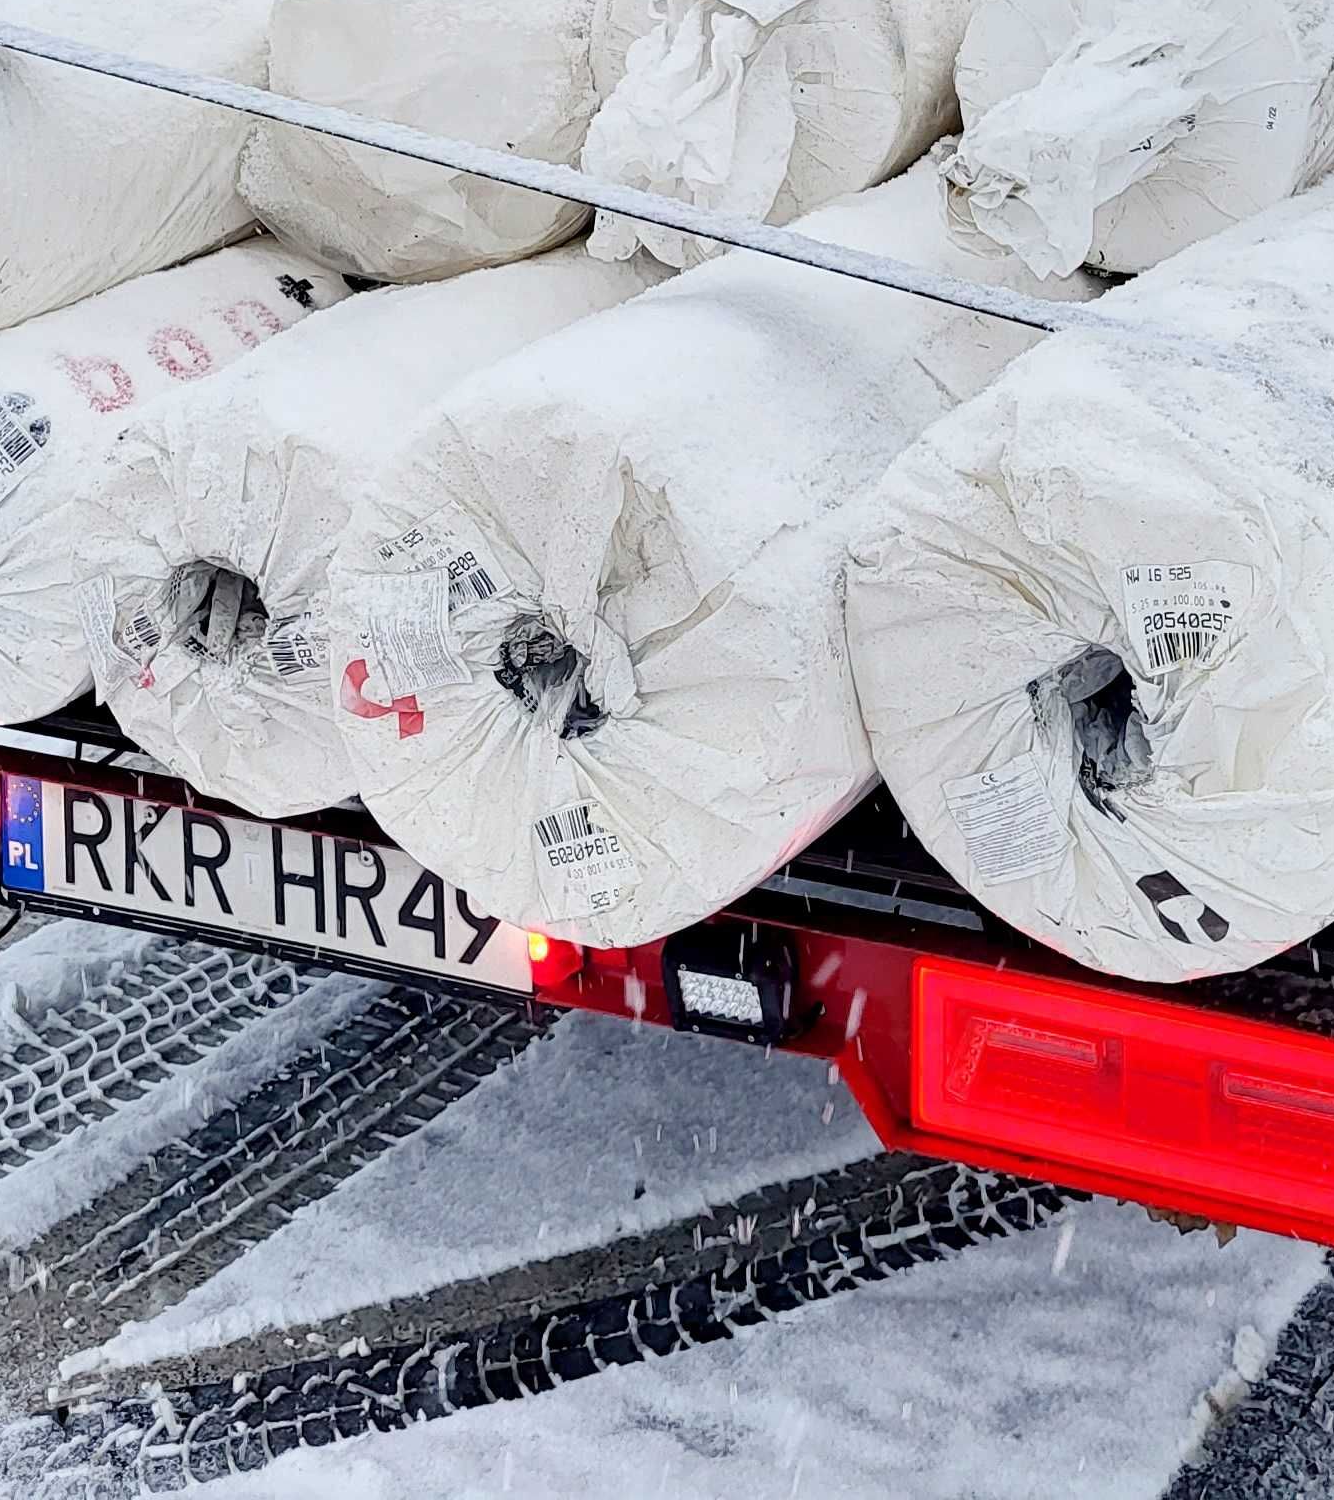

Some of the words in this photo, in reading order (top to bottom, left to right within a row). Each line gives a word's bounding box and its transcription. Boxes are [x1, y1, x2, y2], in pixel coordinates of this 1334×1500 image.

[1148, 568, 1162, 582] 16
[1169, 566, 1192, 581] 525
[8, 840, 38, 871] PL
[66, 789, 234, 914] RKR
[273, 825, 501, 964] HR49
